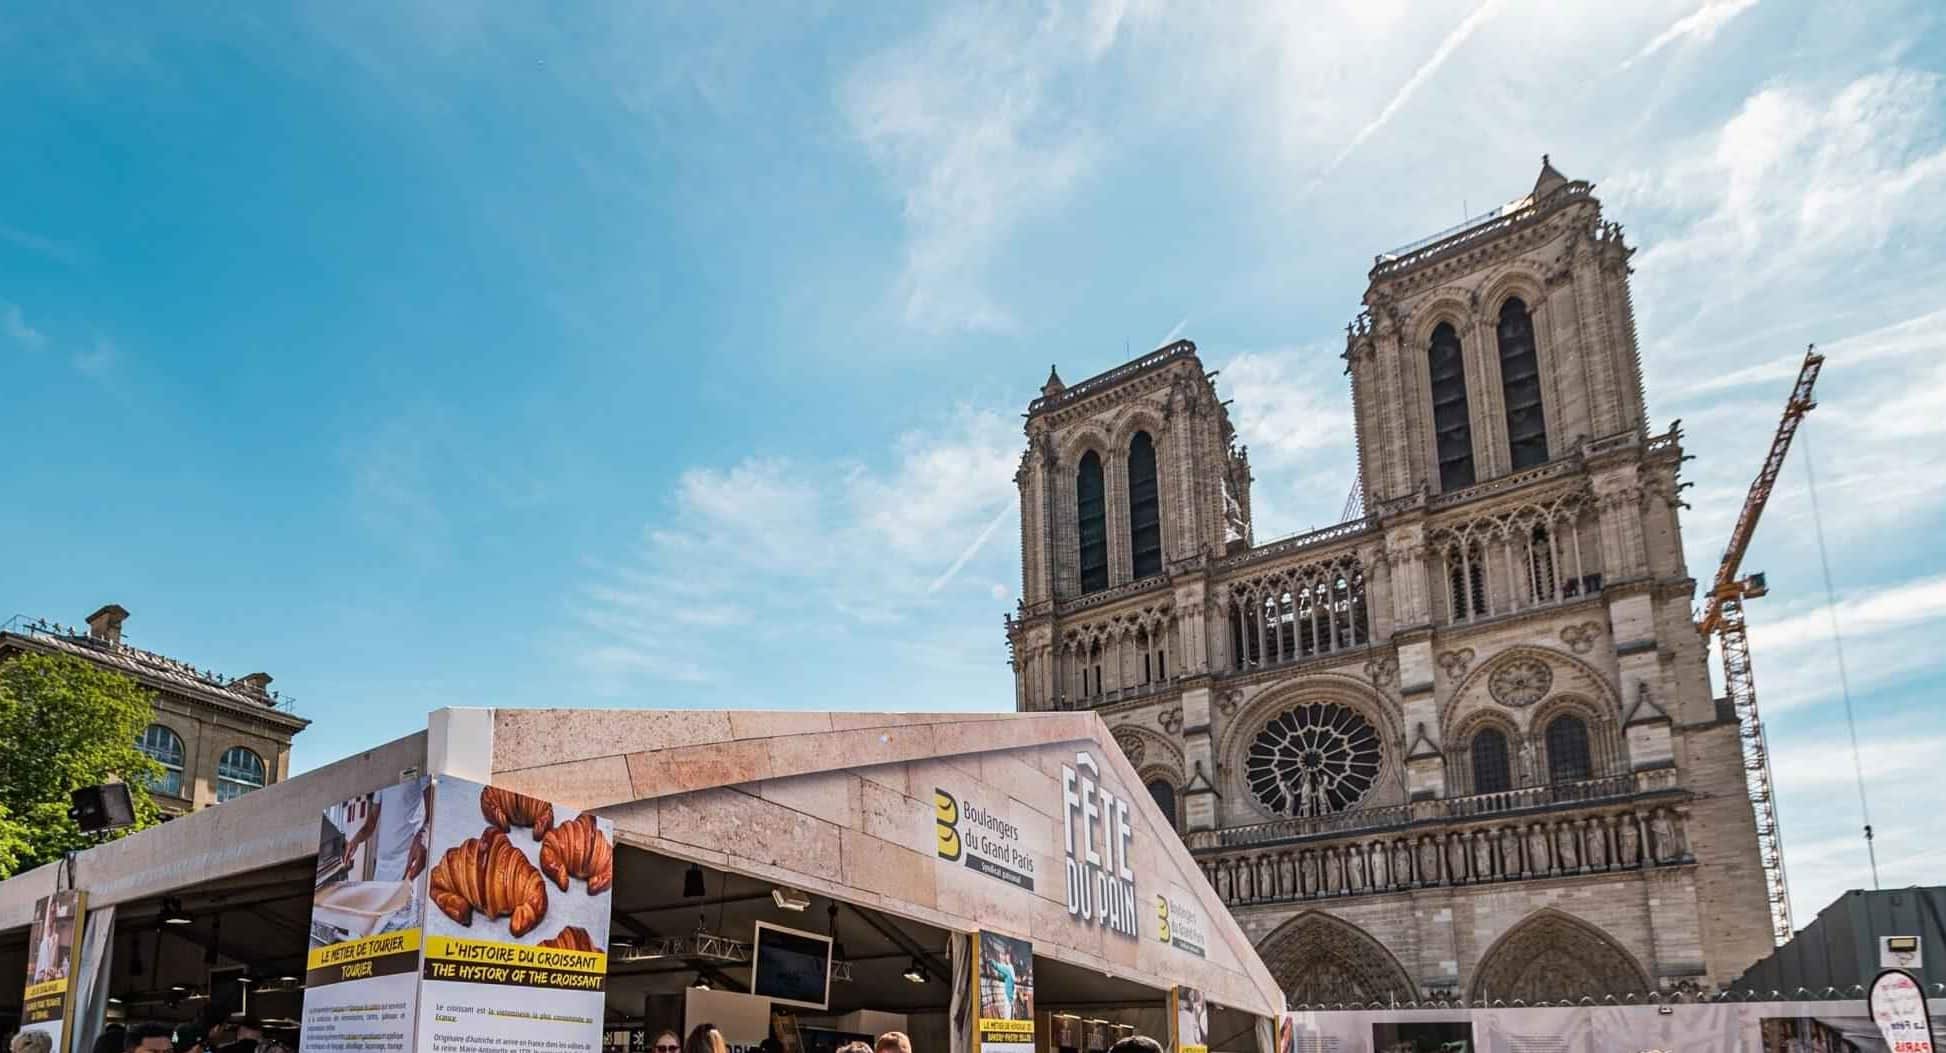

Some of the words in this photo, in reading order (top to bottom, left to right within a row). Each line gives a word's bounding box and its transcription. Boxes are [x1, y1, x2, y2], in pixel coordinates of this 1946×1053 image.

[963, 800, 1019, 841] Boulangers
[1062, 751, 1134, 883] FÊTE
[965, 828, 978, 850] du
[981, 836, 1010, 863] Grand
[1012, 848, 1034, 872] Paris
[1066, 856, 1092, 921] DU
[1097, 869, 1137, 937] PAIN
[356, 942, 369, 956] DE
[369, 936, 405, 955] TOURIER
[445, 943, 515, 962] L'HISTOIRE
[518, 950, 534, 963] DU
[537, 953, 599, 970] CROISSANT
[341, 960, 374, 979] TOURIER
[431, 963, 457, 977] THE
[459, 965, 508, 983] HYSTORY
[511, 970, 526, 982] OF
[530, 970, 548, 984] THE
[551, 973, 603, 990] CROISSANT
